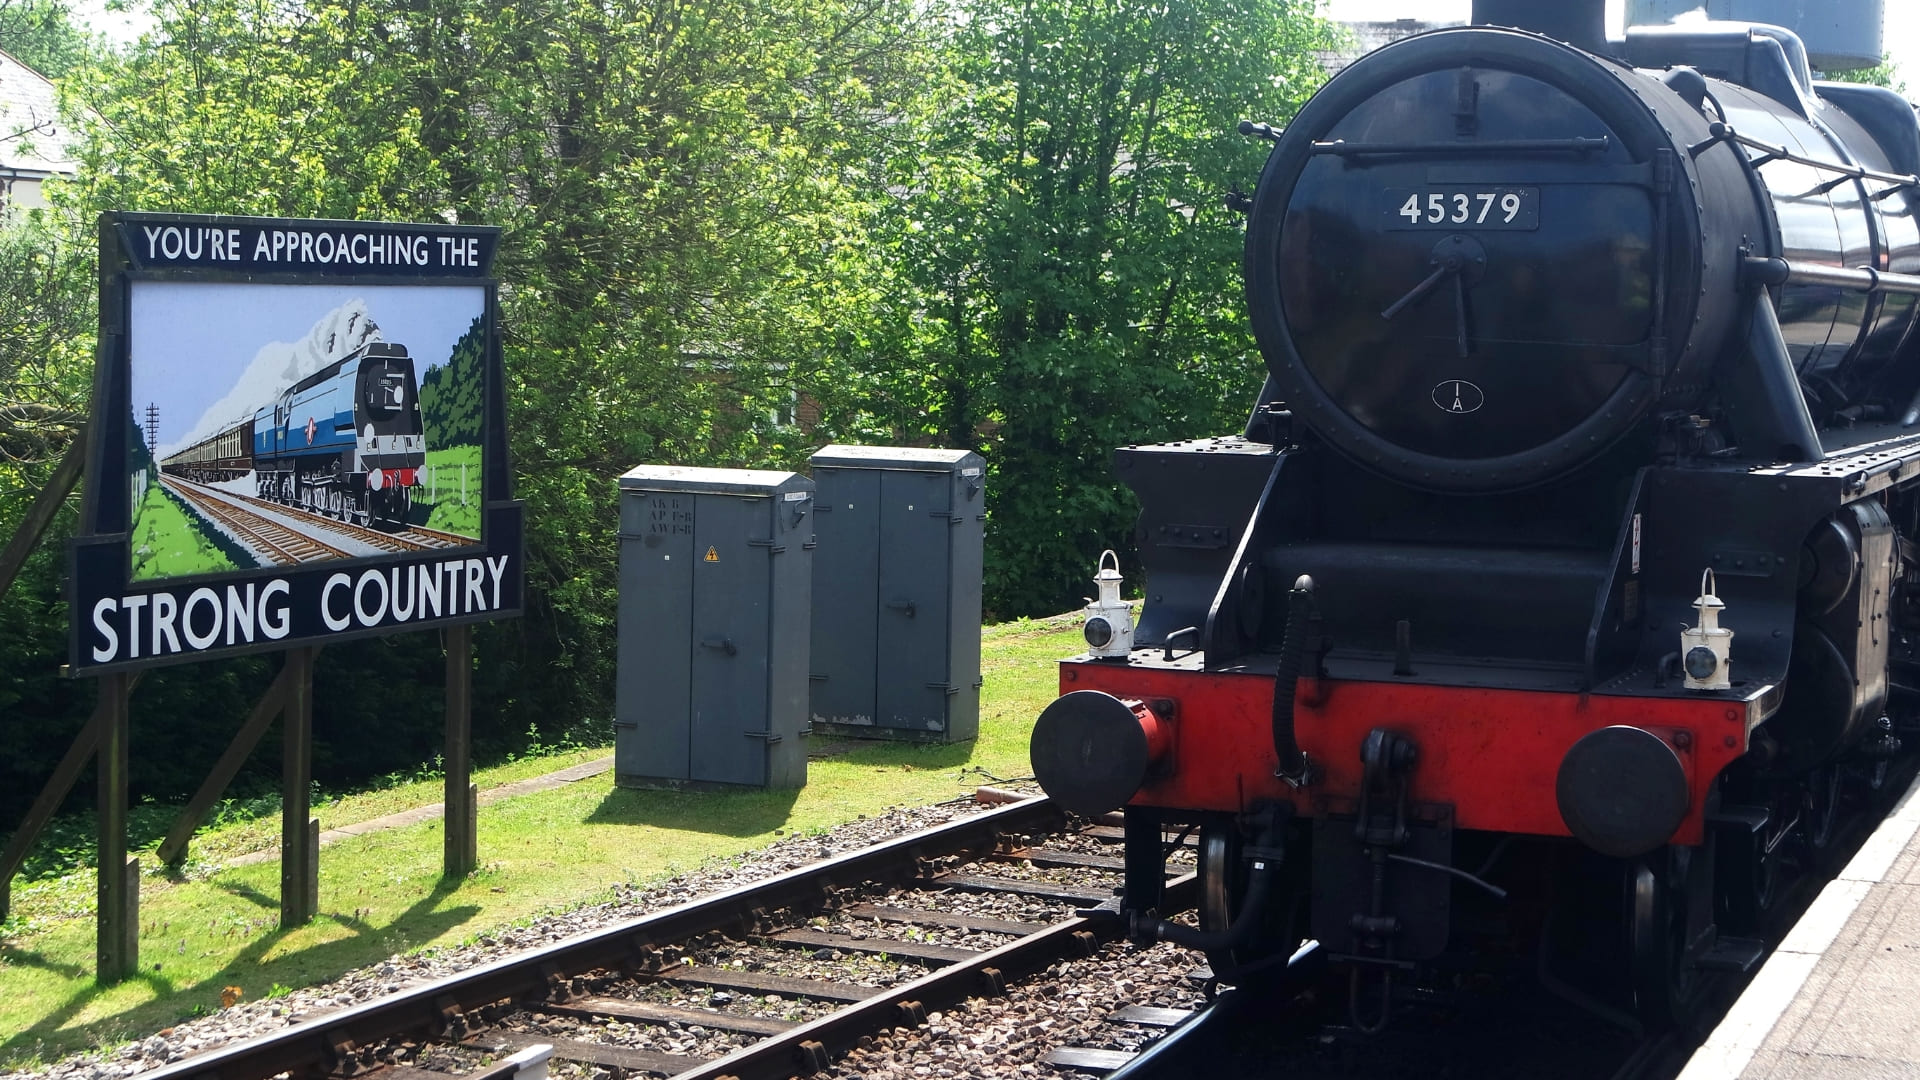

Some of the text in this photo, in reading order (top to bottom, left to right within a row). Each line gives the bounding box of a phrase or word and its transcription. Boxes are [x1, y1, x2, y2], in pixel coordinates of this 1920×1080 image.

[1400, 193, 1520, 224] 45379
[143, 226, 479, 267] YOU'RE APPROACHING THE
[1452, 397, 1463, 411] A
[92, 555, 509, 663] STRONG COUNTRY
